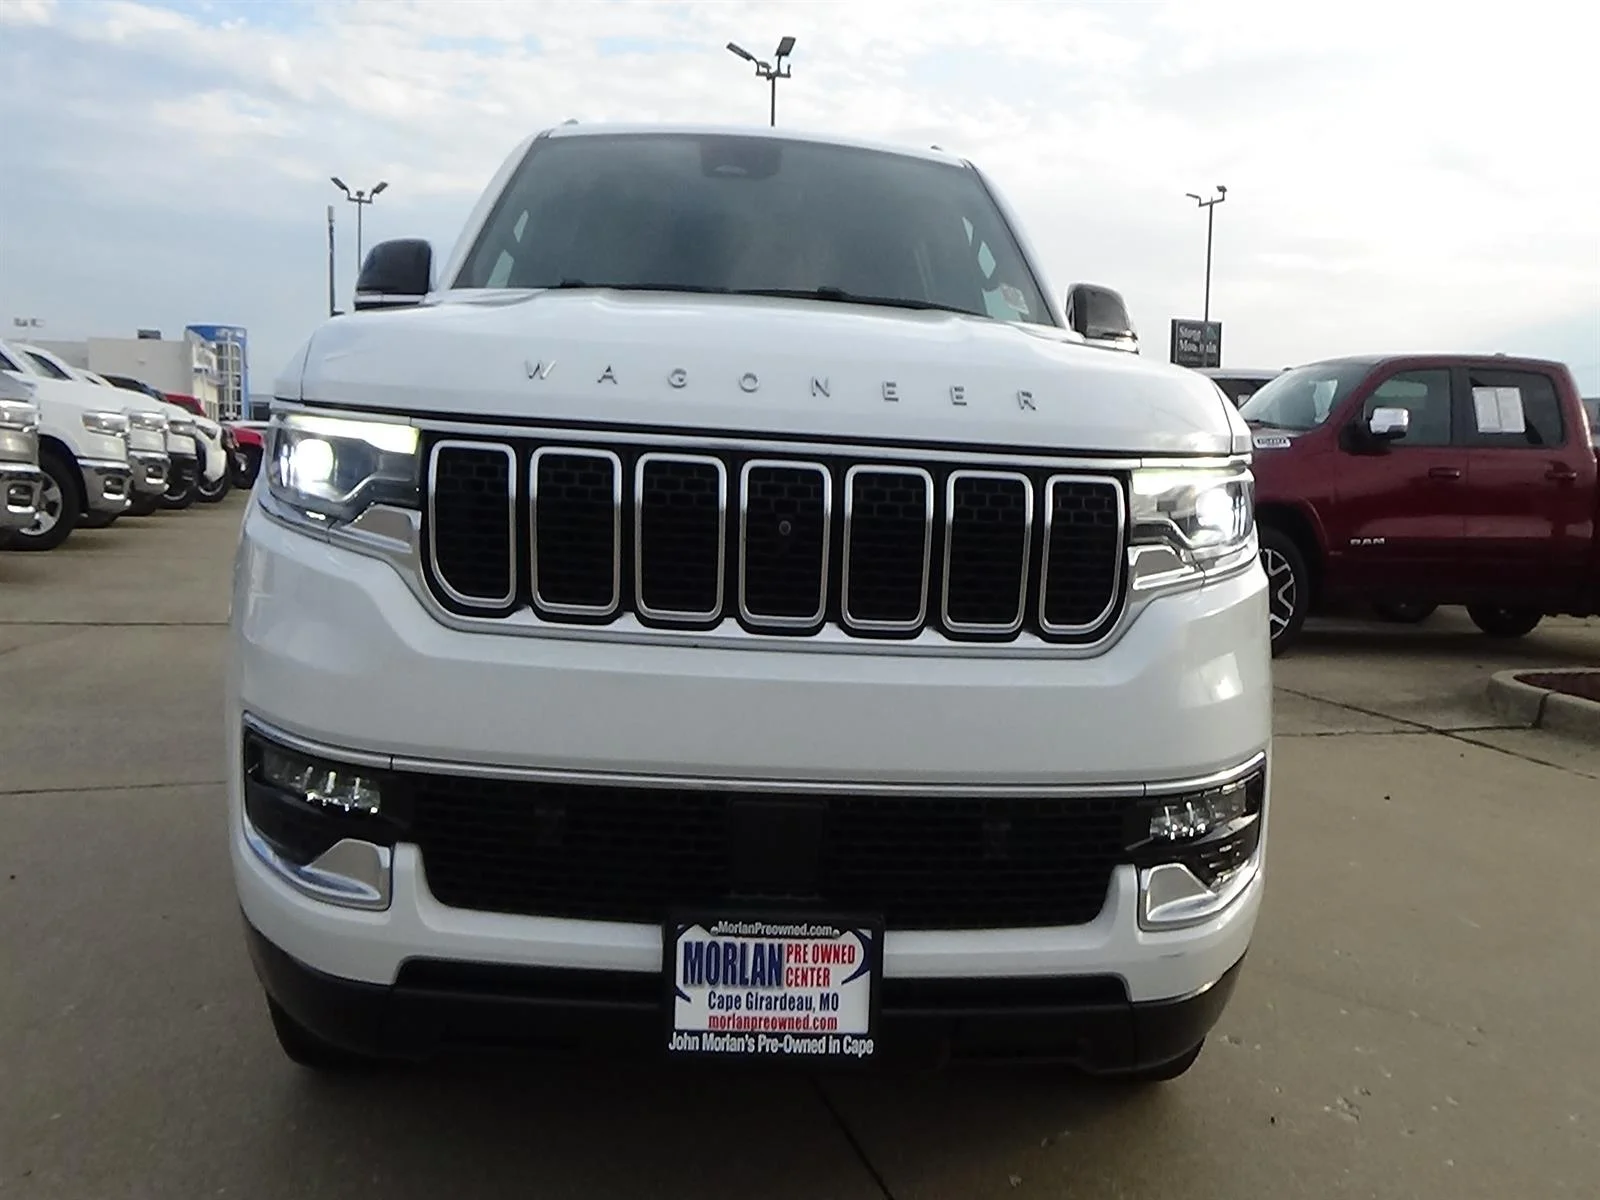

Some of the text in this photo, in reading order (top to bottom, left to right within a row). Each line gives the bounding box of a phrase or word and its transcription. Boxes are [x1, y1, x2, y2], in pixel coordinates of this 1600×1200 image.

[525, 359, 1037, 411] WAGONEER
[1350, 537, 1385, 546] RAM
[718, 920, 833, 937] MorlanPreowned.com
[682, 940, 785, 988] MORLAN
[786, 943, 856, 965] PRE OWNED
[785, 966, 831, 988] CENTER
[708, 991, 840, 1014] Cape Girardeau, MO
[708, 1013, 838, 1032] morlanpreowned.com
[668, 1032, 699, 1051] John
[702, 1033, 755, 1053] Morlan's
[758, 1034, 826, 1054] Pre-Owned
[842, 1035, 874, 1058] Cape
